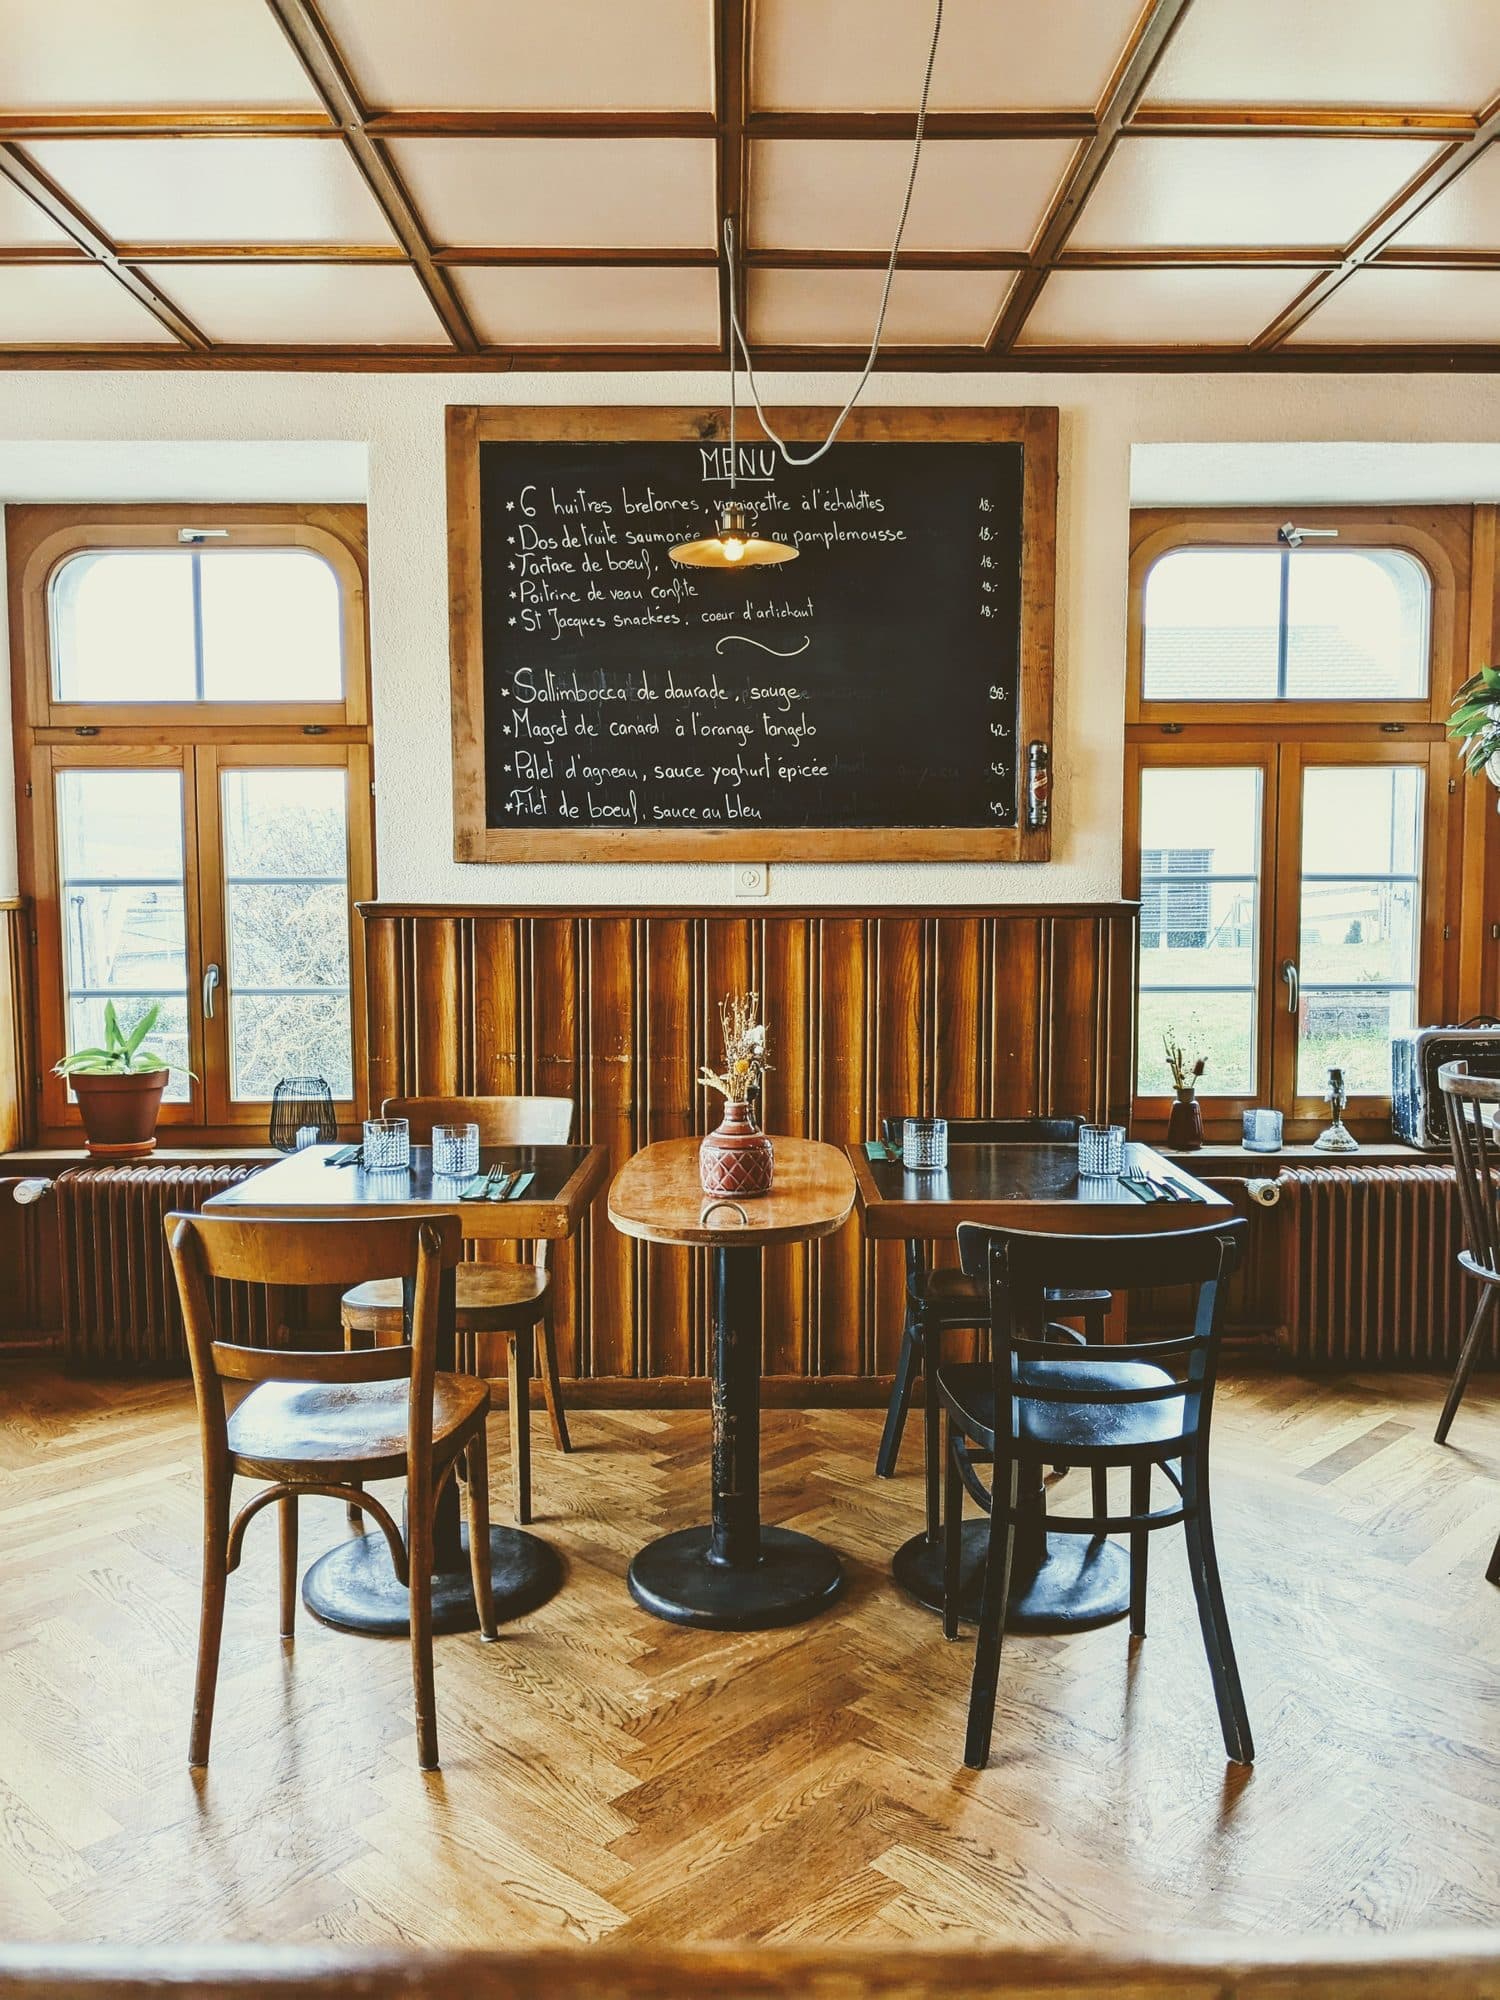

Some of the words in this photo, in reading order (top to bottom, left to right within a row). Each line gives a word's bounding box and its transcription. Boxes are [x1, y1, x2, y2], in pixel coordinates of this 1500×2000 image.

[700, 447, 775, 478] MENU
[520, 486, 537, 517] 6
[518, 524, 558, 550] Dos
[562, 524, 580, 547] de
[581, 521, 617, 547] truite
[771, 530, 788, 542] au
[793, 521, 907, 550] pamplemousse
[515, 553, 576, 576] Tartare
[582, 553, 603, 573] de
[520, 579, 581, 604] Poitrine
[588, 580, 606, 600] de
[609, 589, 642, 600] veau
[650, 578, 699, 603] confite
[520, 608, 542, 632] St
[547, 608, 606, 640] Jacques
[701, 610, 735, 622] coeur
[743, 597, 814, 620] d'artichaut
[513, 667, 627, 704] Saltimbocca
[637, 669, 660, 700] de
[512, 707, 568, 745] Magret
[575, 713, 600, 737] de
[609, 713, 660, 737] canard
[691, 711, 754, 747] l'orange
[763, 711, 817, 747] tangelo
[515, 750, 554, 780] Palet
[655, 766, 704, 779] sauce
[712, 752, 770, 787] yoghurt
[777, 756, 829, 783] épicée
[510, 786, 547, 816] Filet
[559, 790, 579, 818] de
[653, 805, 698, 820] sauce
[702, 807, 722, 819] au
[725, 793, 762, 820] bleu
